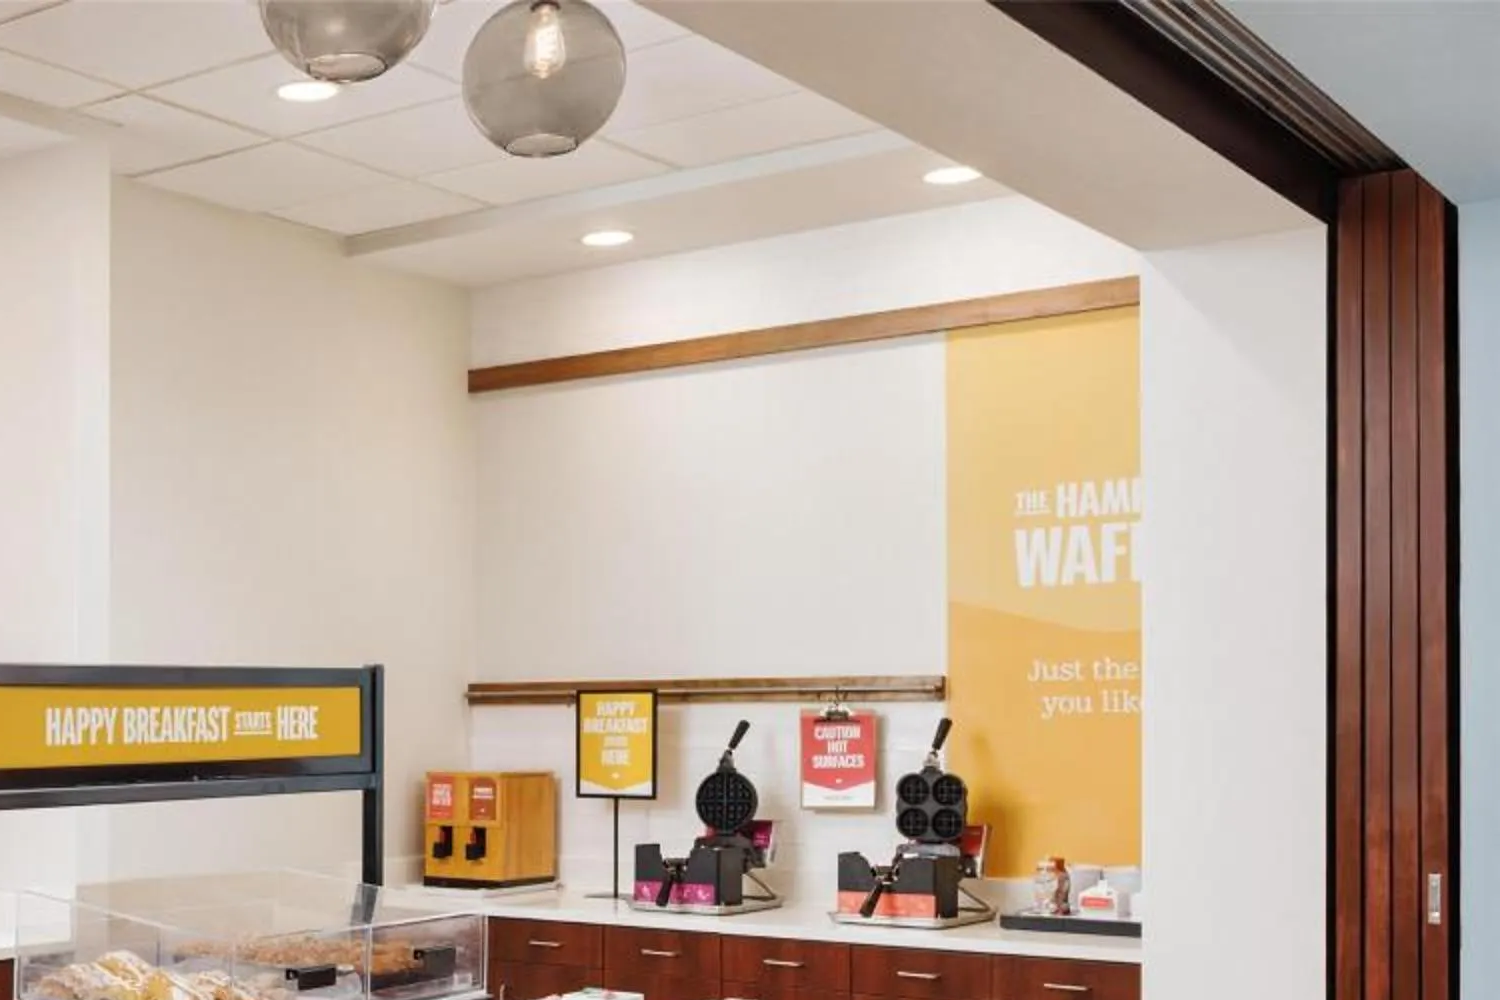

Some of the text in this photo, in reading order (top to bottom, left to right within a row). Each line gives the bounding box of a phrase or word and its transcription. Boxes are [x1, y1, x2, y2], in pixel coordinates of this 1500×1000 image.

[1015, 489, 1050, 511] THE
[1027, 656, 1140, 683] Just the
[1041, 694, 1093, 719] you
[45, 706, 117, 746] HAPPY
[123, 705, 231, 743] BREAKFAST
[276, 705, 319, 741] HERE
[814, 725, 861, 740] CAUTION
[827, 740, 848, 754] HOT
[812, 753, 866, 770] SURFACES
